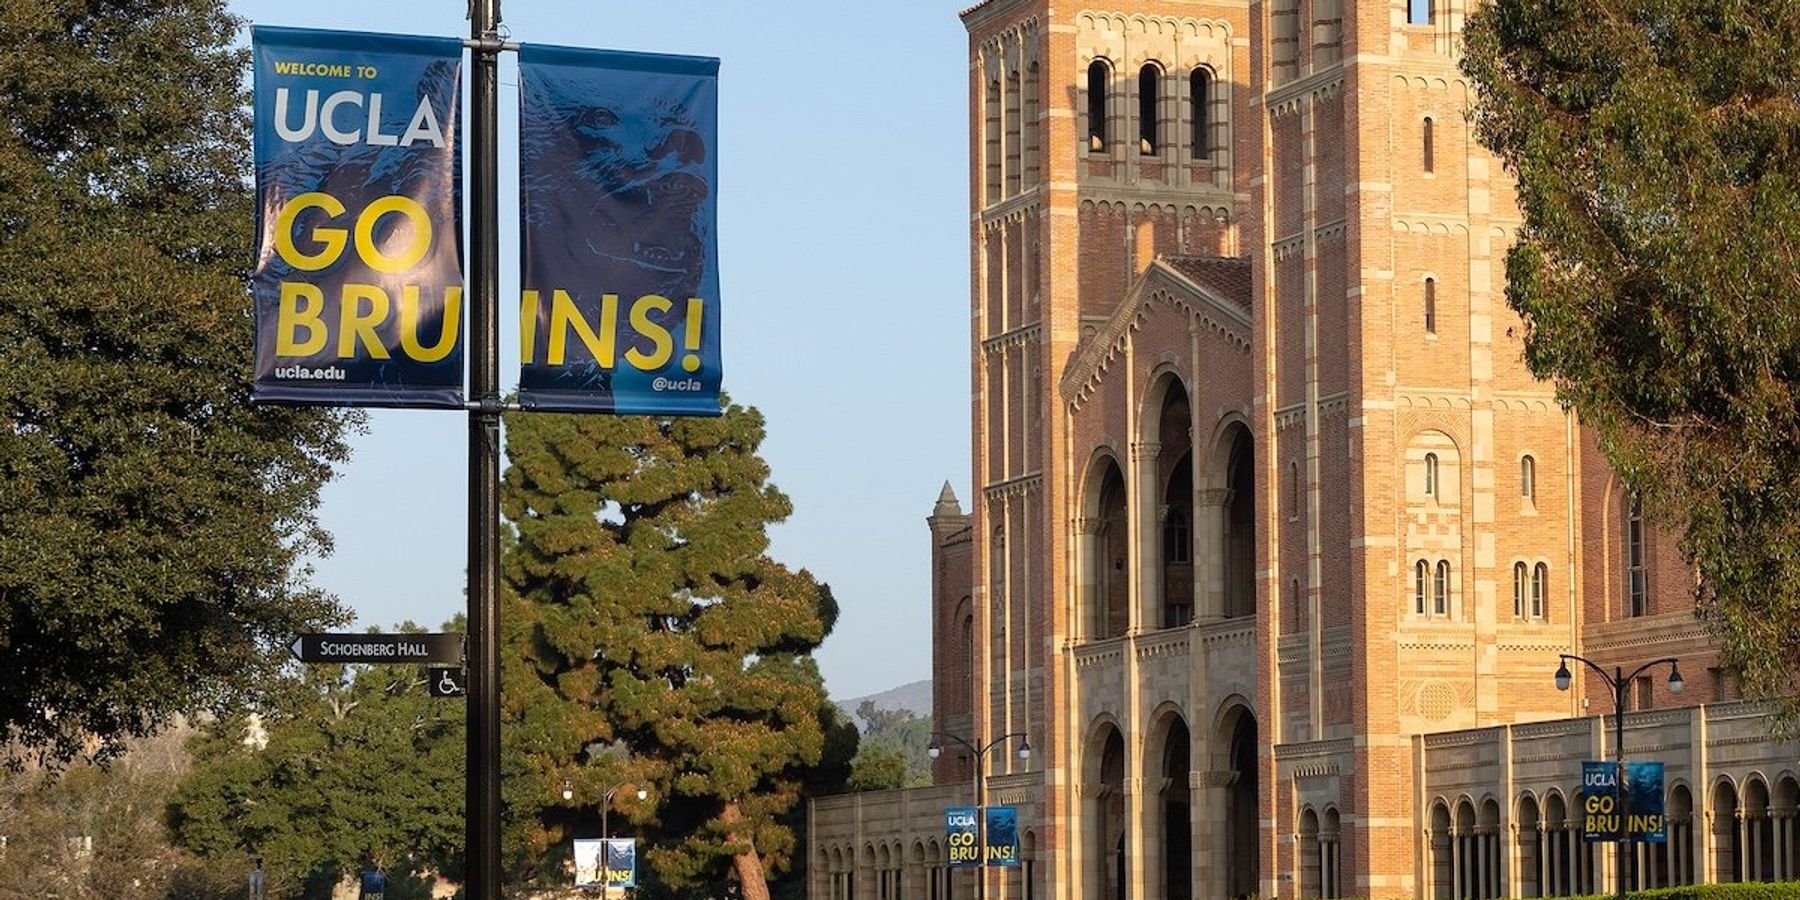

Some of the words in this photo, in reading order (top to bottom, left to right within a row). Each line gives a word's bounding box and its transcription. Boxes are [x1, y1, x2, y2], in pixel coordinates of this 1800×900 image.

[274, 62, 351, 78] WELCOME
[357, 66, 377, 79] TO
[274, 88, 446, 148] UCLA
[275, 192, 433, 273] GO
[276, 282, 462, 362] BRU
[275, 365, 346, 380] ucla.edu
[652, 377, 701, 391] @ucla
[320, 641, 394, 656] SCHOENBERG
[398, 642, 428, 656] HALL
[1585, 773, 1616, 786] UCLA
[1585, 795, 1614, 814] GO
[948, 815, 976, 826] UCLA
[1585, 814, 1620, 833] BRU
[949, 832, 975, 846] GO
[950, 847, 979, 860] BRU
